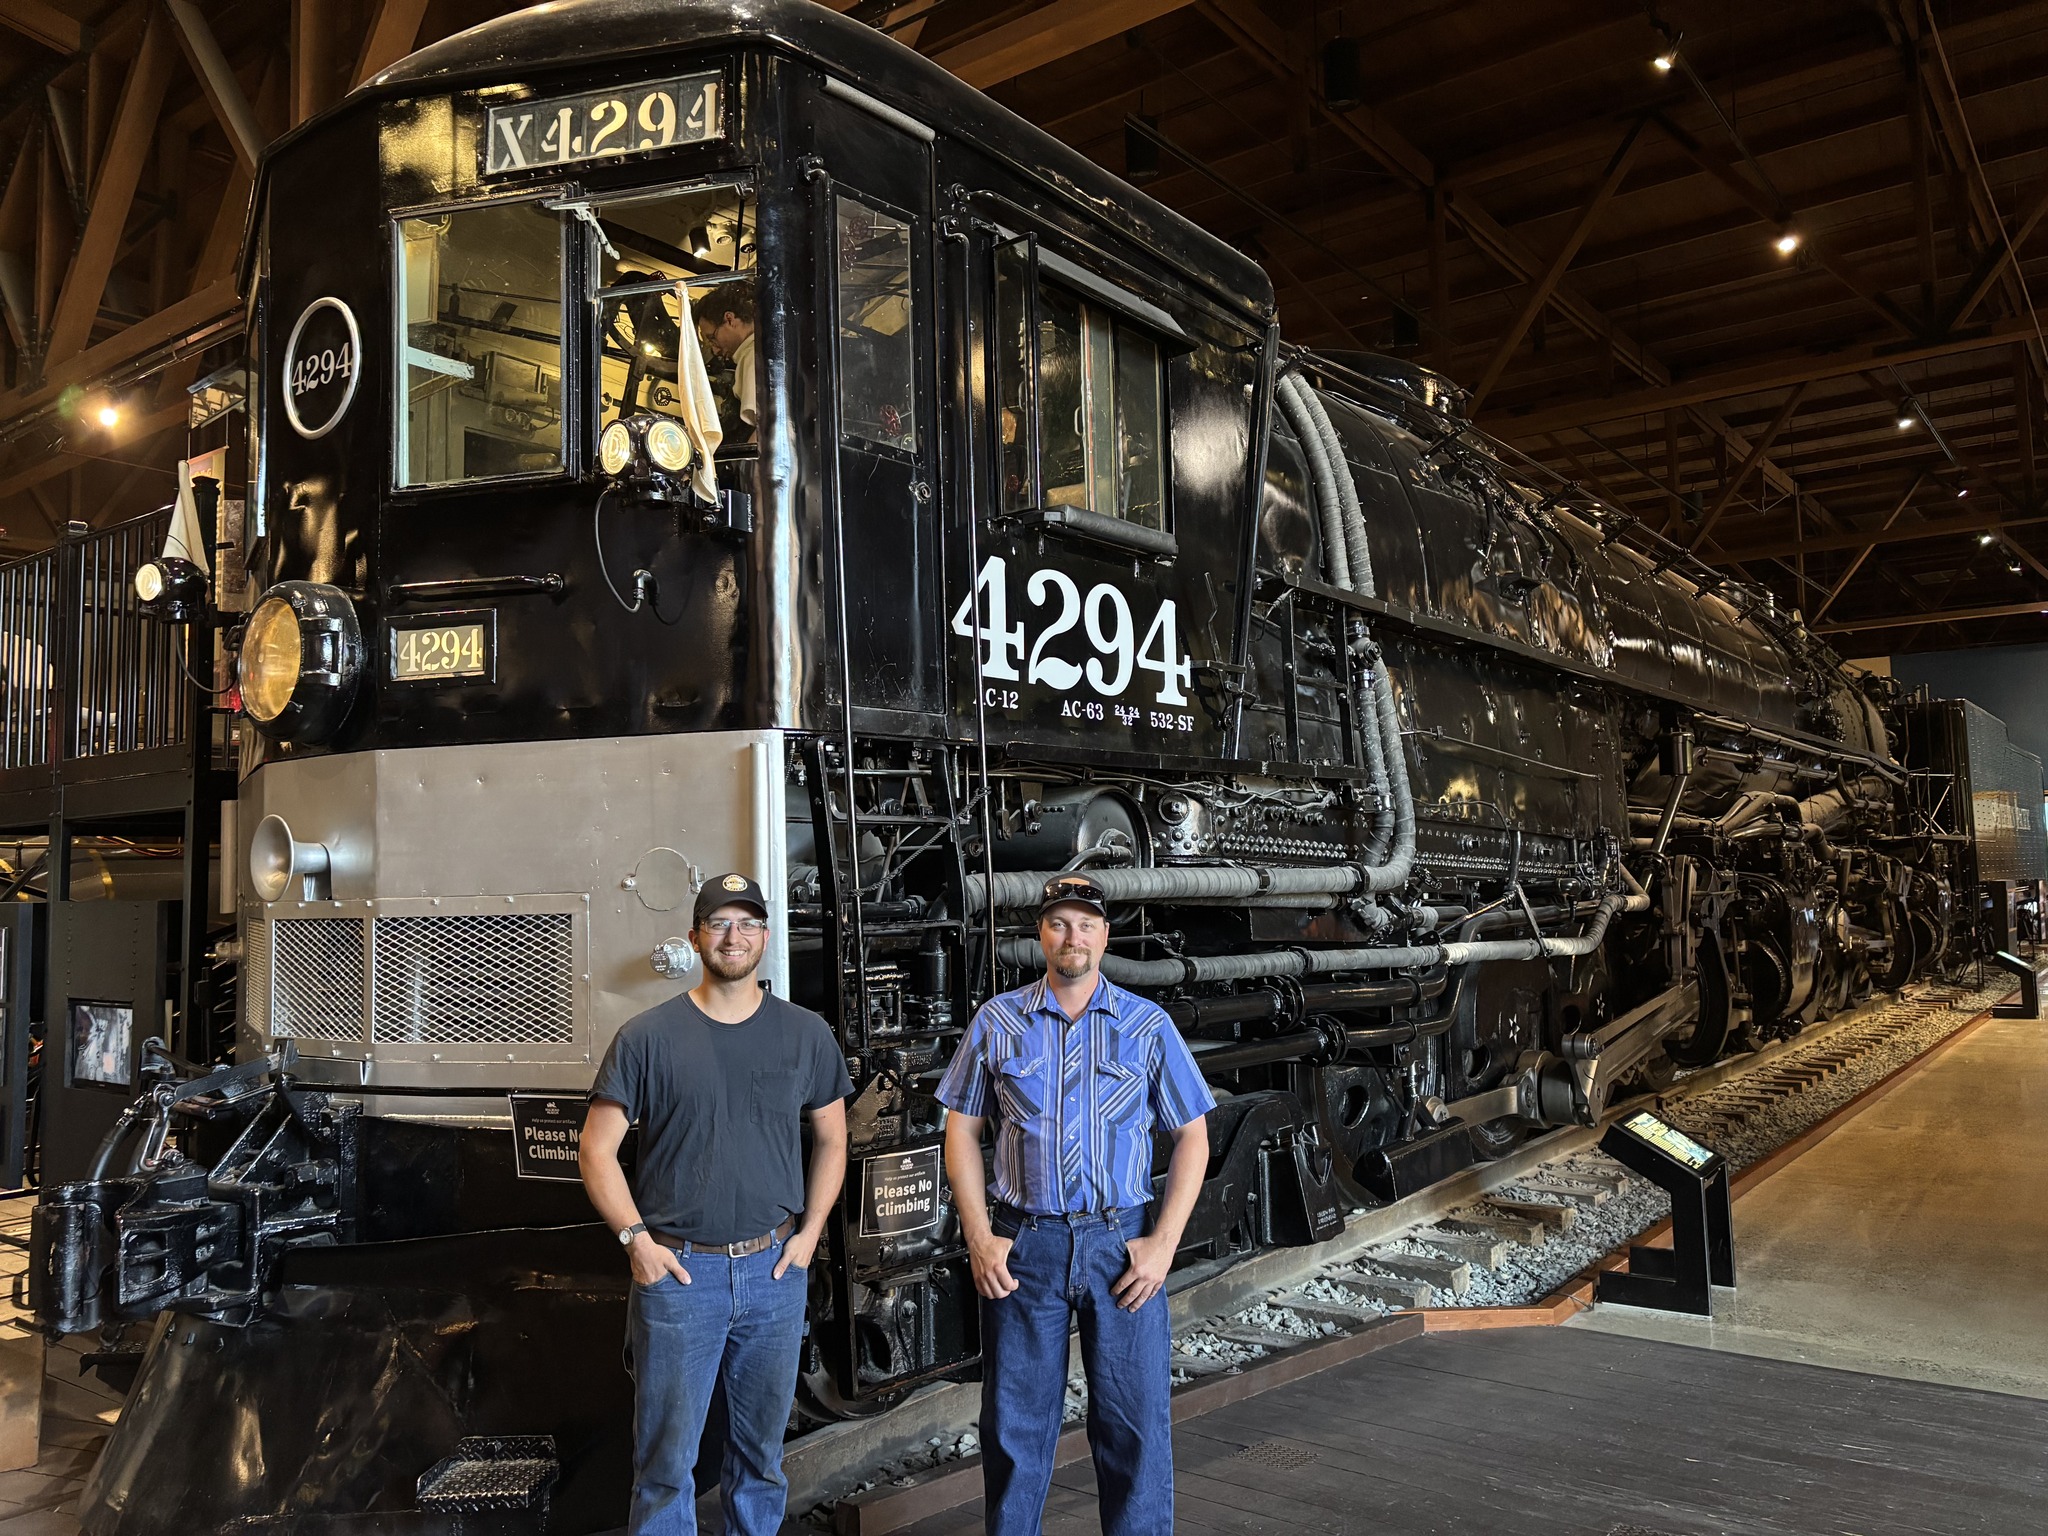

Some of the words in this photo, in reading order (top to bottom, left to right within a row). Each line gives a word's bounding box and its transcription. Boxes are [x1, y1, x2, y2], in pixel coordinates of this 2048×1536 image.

[497, 83, 718, 167] X4294
[292, 342, 353, 396] 4294
[951, 555, 1192, 707] 4294
[400, 628, 483, 672] 4294
[1061, 700, 1104, 721] AC-63
[1114, 704, 1126, 715] 24
[1128, 706, 1140, 718] 24
[1150, 711, 1195, 732] 532-SF
[1122, 716, 1133, 727] 32
[524, 1126, 566, 1142] Please
[529, 1144, 580, 1161] Climbin
[874, 1184, 916, 1200] Please
[918, 1179, 932, 1193] No
[876, 1197, 931, 1217] Climbing
